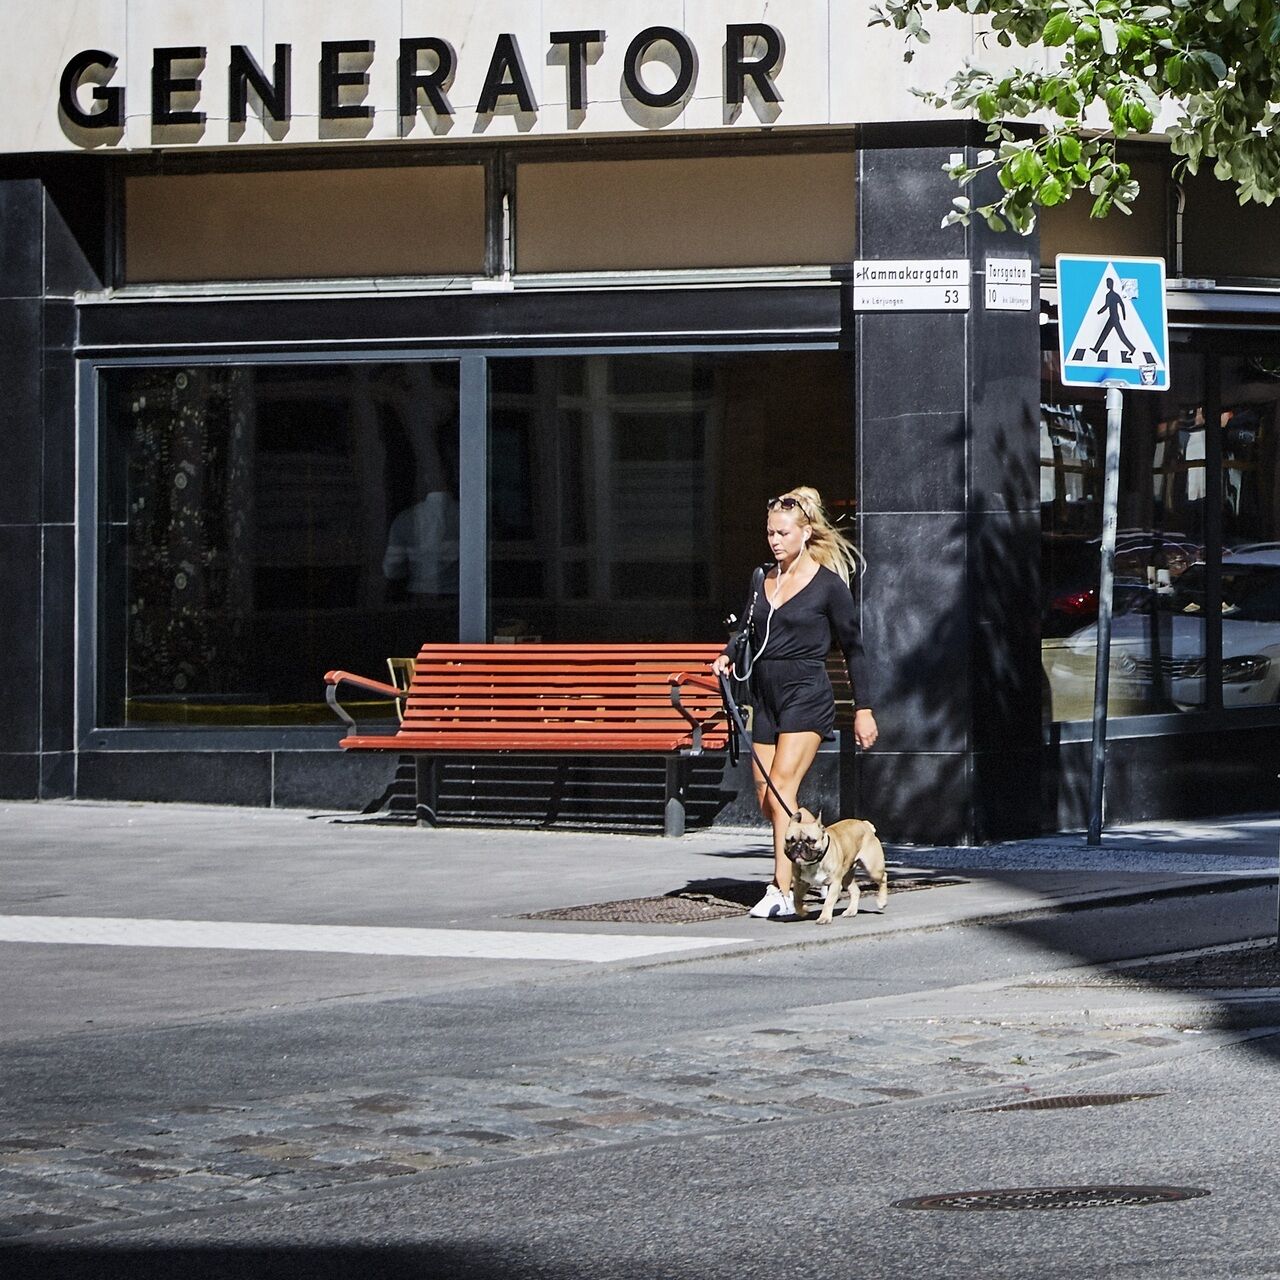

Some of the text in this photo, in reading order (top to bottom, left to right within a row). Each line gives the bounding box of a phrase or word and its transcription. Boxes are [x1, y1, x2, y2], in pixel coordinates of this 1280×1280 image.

[59, 23, 785, 129] GENERATOR
[862, 266, 959, 283] Kammakargatan
[989, 264, 1026, 282] Torsgatan
[944, 289, 959, 304] 53
[988, 289, 997, 303] 10
